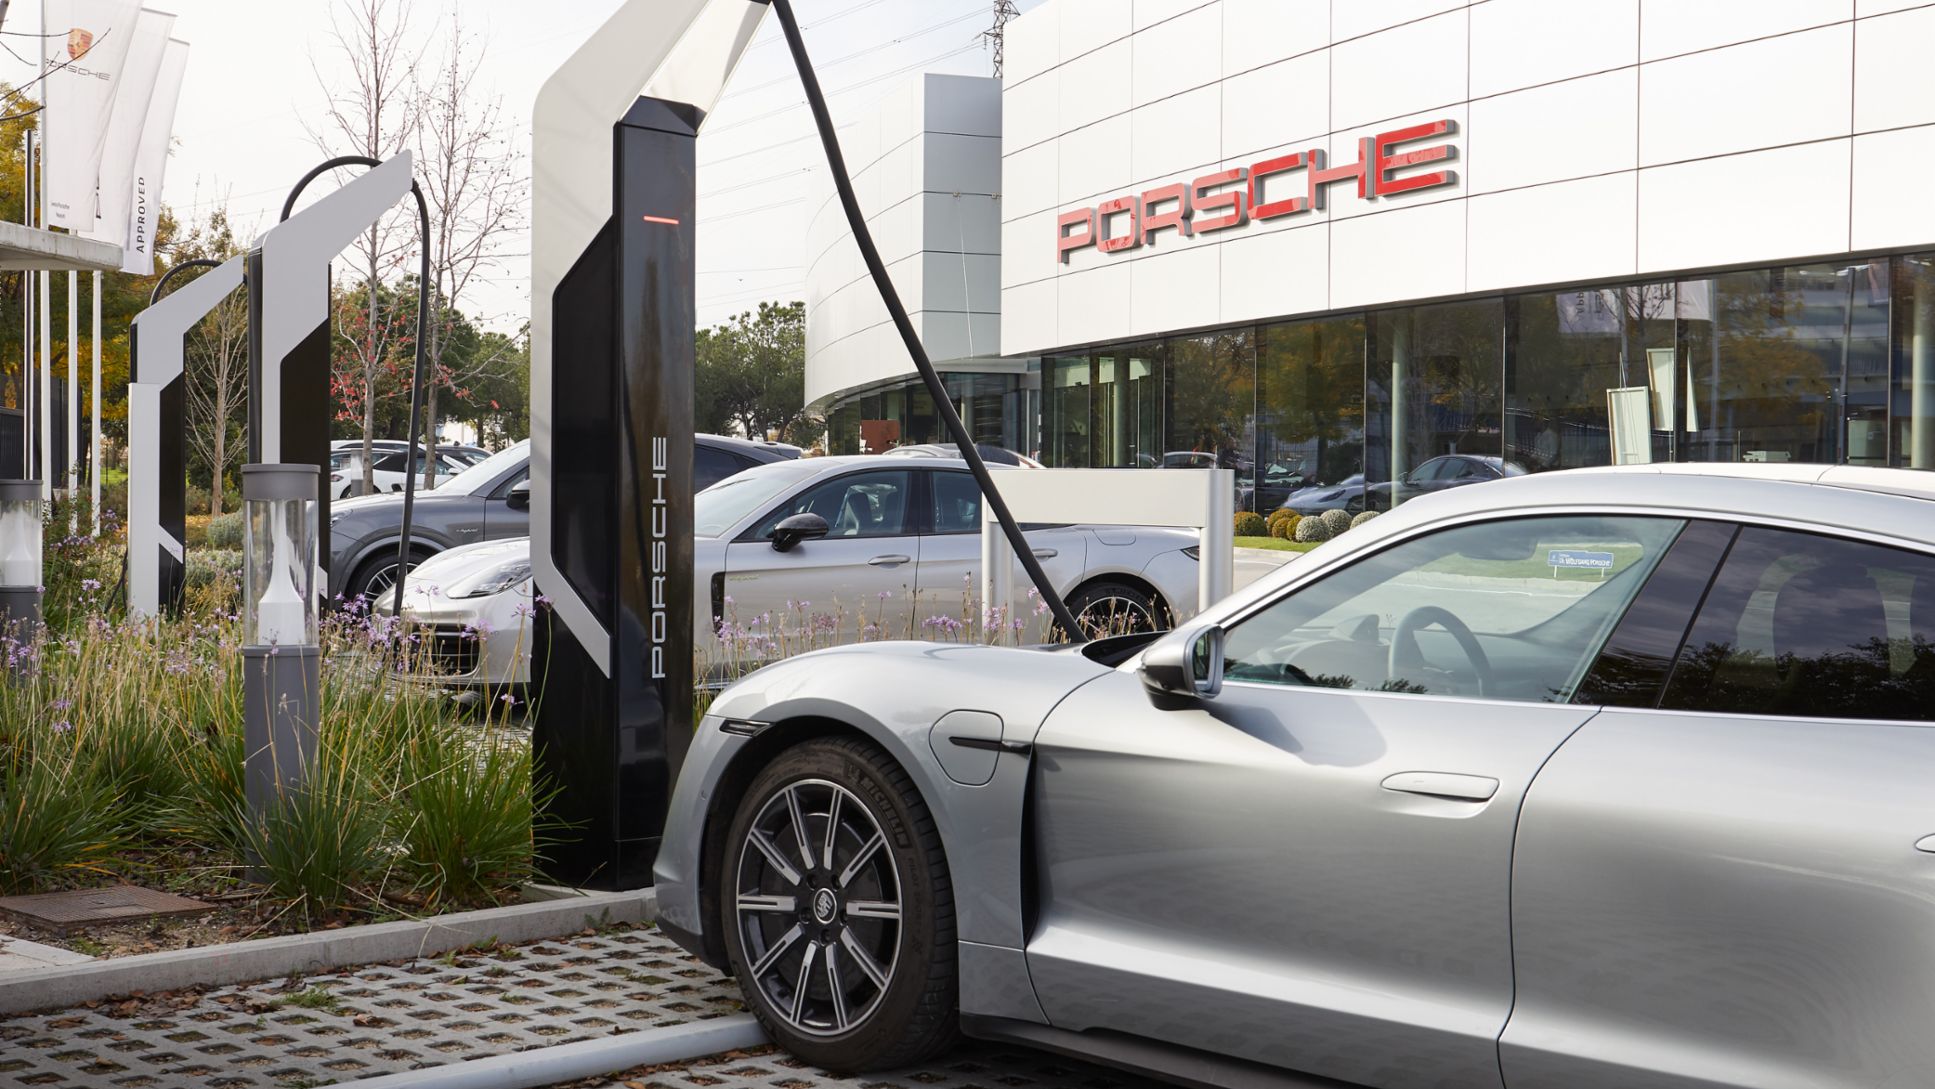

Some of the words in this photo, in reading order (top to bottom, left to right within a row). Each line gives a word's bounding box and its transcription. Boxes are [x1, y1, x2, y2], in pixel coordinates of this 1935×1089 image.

[136, 176, 146, 254] APPROVED
[1057, 118, 1460, 265] PORSCHE
[652, 436, 667, 679] PORSCHE
